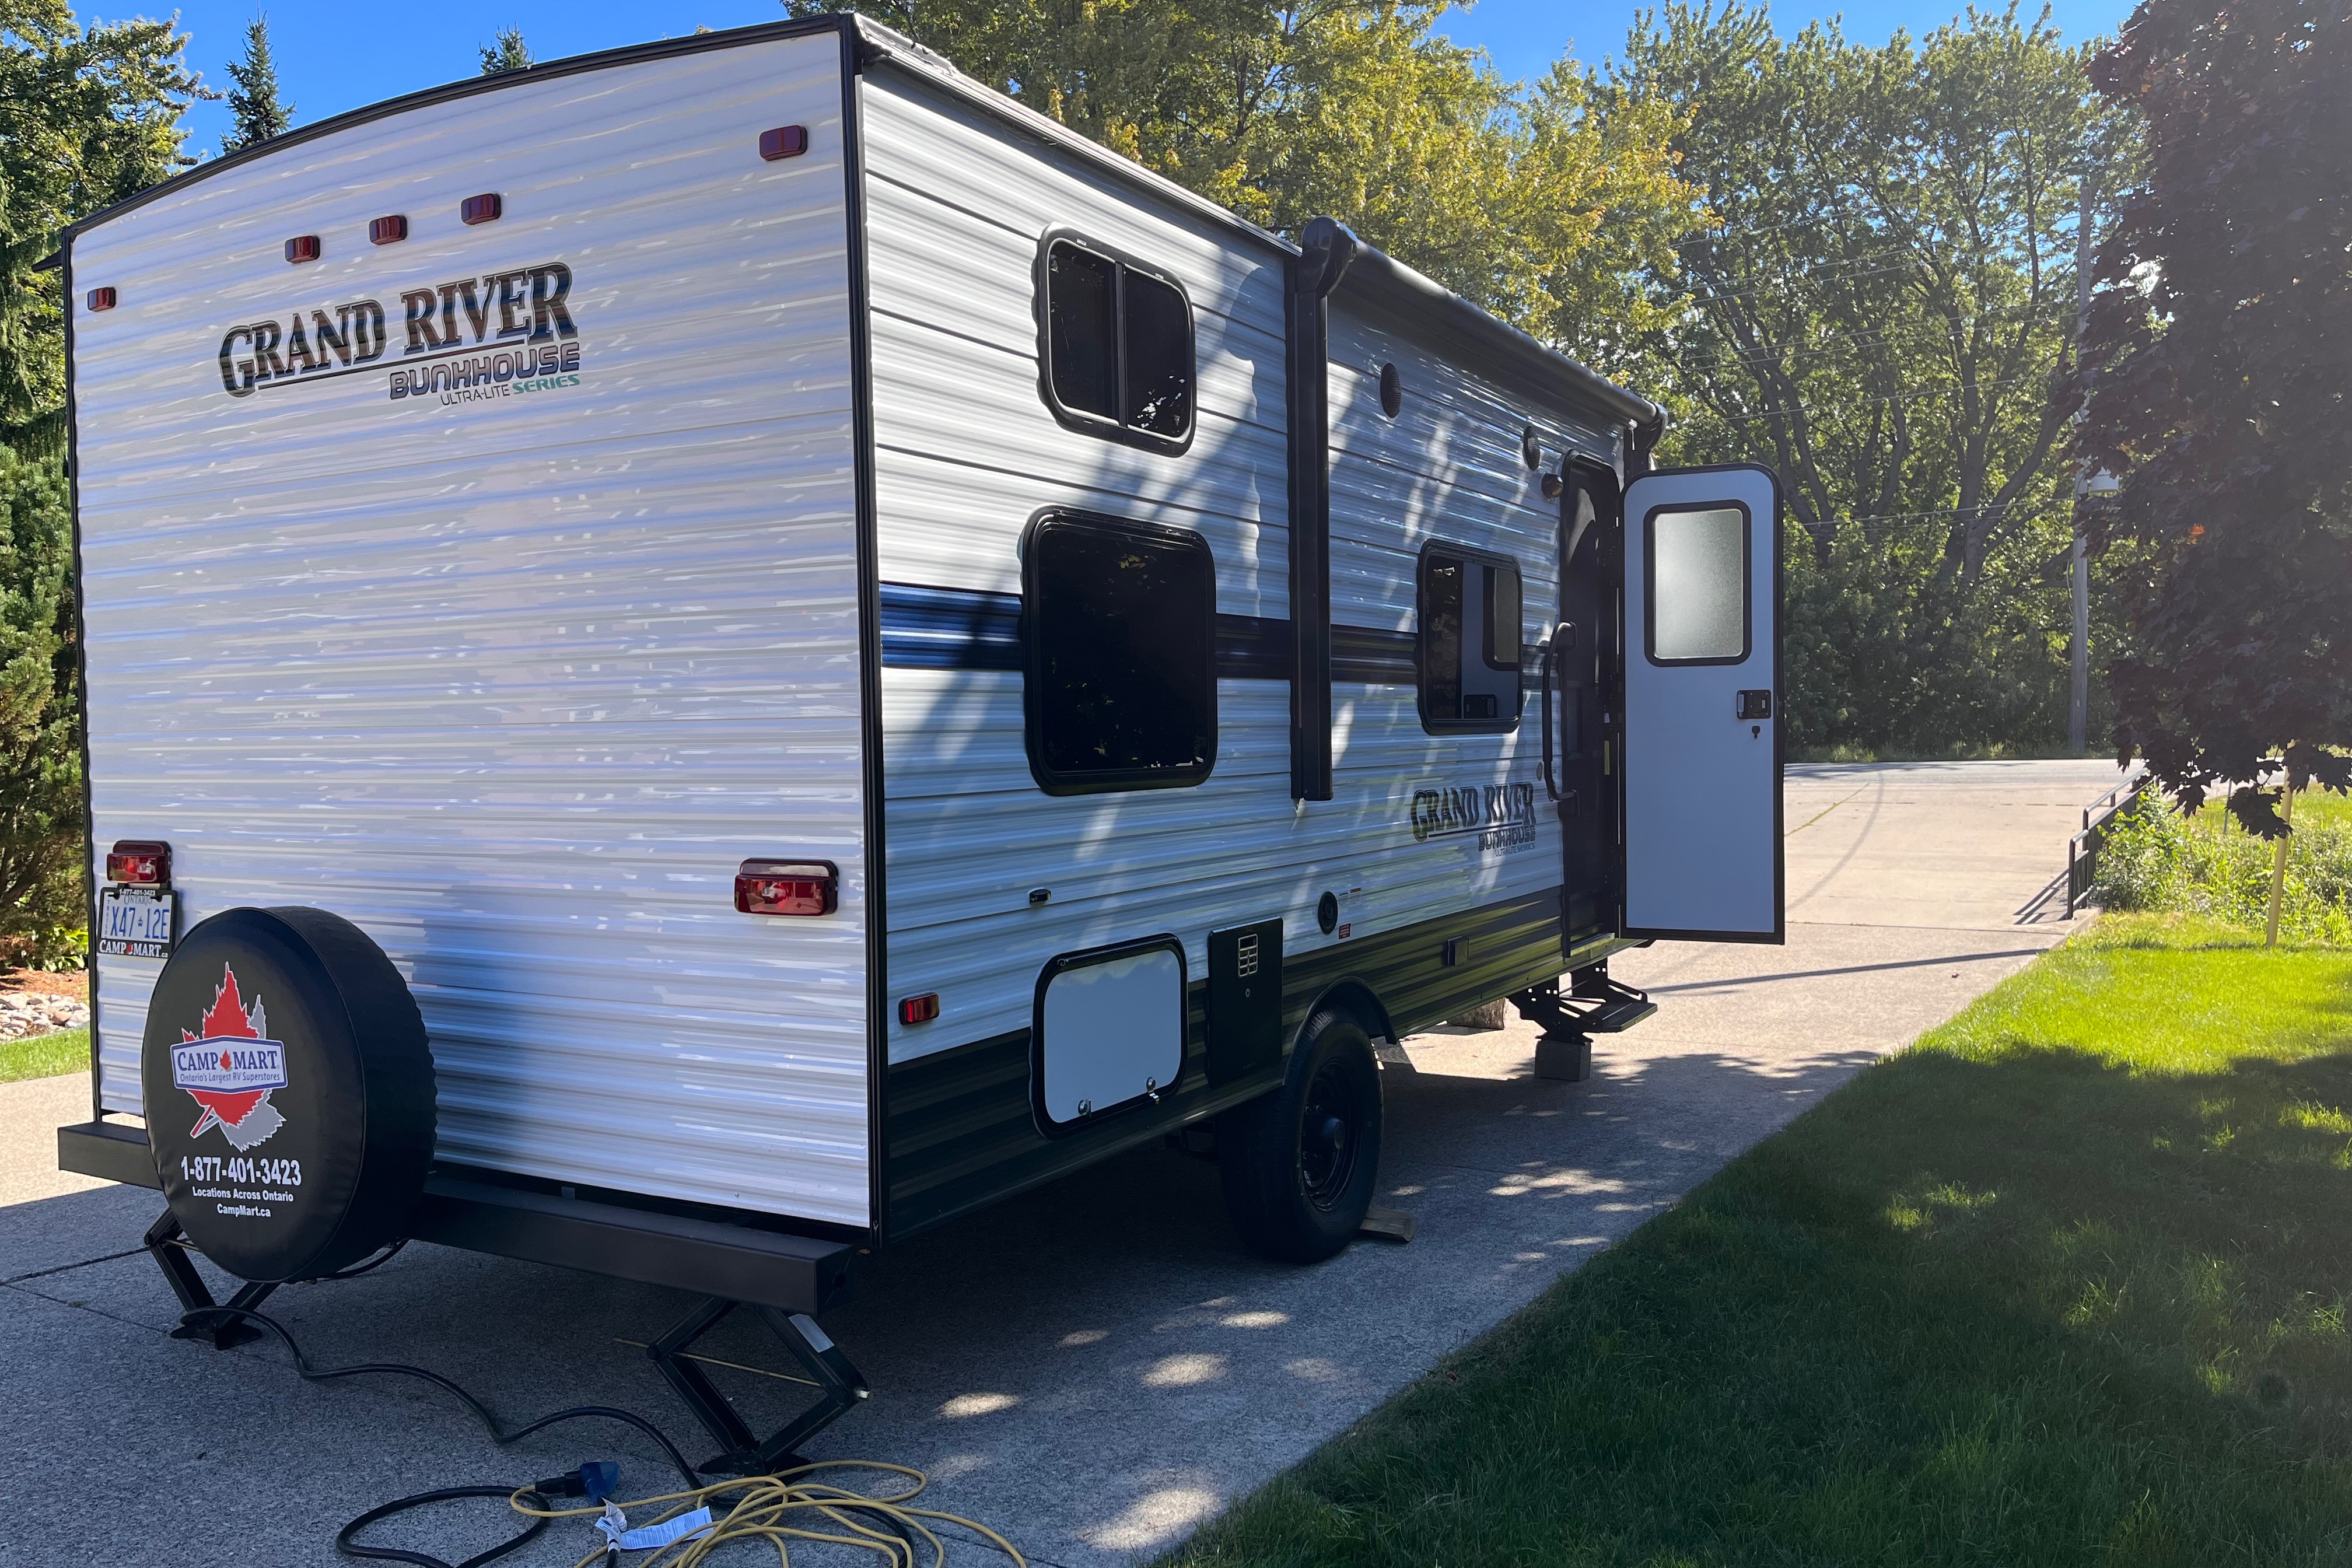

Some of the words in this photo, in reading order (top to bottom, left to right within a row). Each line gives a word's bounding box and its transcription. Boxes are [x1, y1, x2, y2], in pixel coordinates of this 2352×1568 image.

[218, 299, 386, 398] GRAND
[401, 262, 578, 355] RIVER
[390, 342, 580, 400] BUNKHOUSE
[440, 384, 510, 405] ULTRA-LITE
[512, 373, 580, 394] SERIES
[1410, 786, 1479, 842] GRAND
[1483, 782, 1536, 826] RIVER
[1478, 825, 1536, 852] BUNKHOUSE
[110, 907, 135, 937] X47
[145, 908, 169, 940] 12E
[99, 940, 127, 954] CAMP
[177, 1052, 218, 1071] CAMP
[233, 1051, 277, 1070] MART
[180, 1072, 207, 1082] Ontario's
[209, 1073, 232, 1084] Largest
[233, 1072, 241, 1080] RV
[243, 1072, 280, 1083] Superstores
[181, 1156, 302, 1186] 1-877-401-3423
[192, 1186, 231, 1199] Locations
[233, 1188, 261, 1200] Across
[262, 1190, 294, 1202] Ontario
[217, 1203, 271, 1217] CampMart.ca
